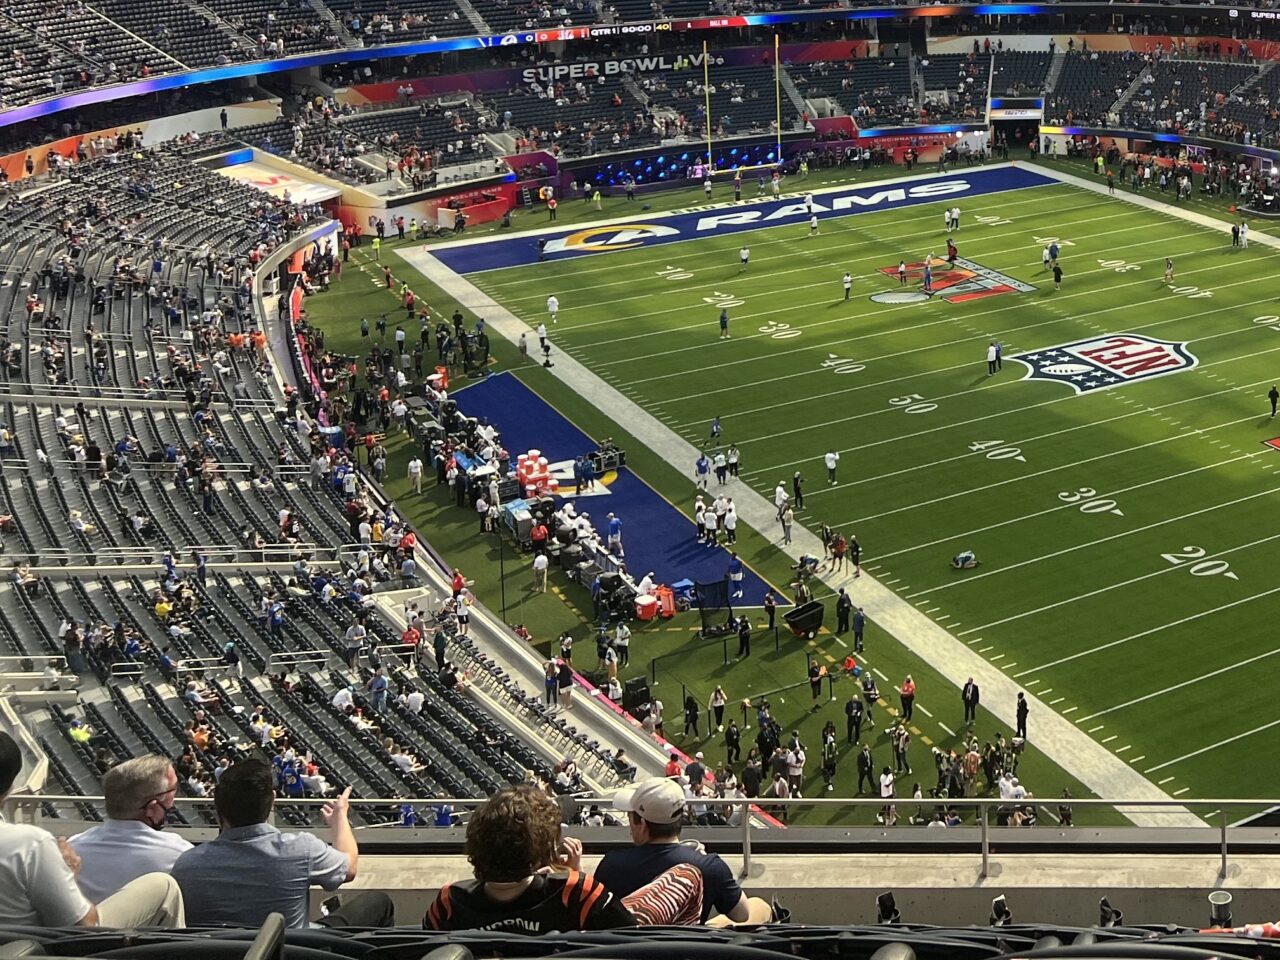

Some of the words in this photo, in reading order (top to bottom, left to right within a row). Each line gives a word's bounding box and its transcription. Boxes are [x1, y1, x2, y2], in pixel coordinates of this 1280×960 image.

[591, 28, 610, 36] QTR
[622, 25, 652, 33] 90:00
[656, 23, 669, 31] 40
[523, 63, 599, 83] SUPER
[605, 56, 672, 75] BOWL
[696, 180, 971, 230] RAMS
[655, 268, 694, 280] 10
[1100, 259, 1142, 273] 30
[703, 294, 745, 308] 20
[1172, 286, 1214, 299] 40
[758, 322, 802, 339] 30
[820, 358, 866, 374] 40
[1077, 338, 1181, 377] NFL
[888, 393, 938, 414] 50
[967, 440, 1022, 460] 40
[1058, 487, 1117, 513] 30
[1161, 545, 1229, 576] 20
